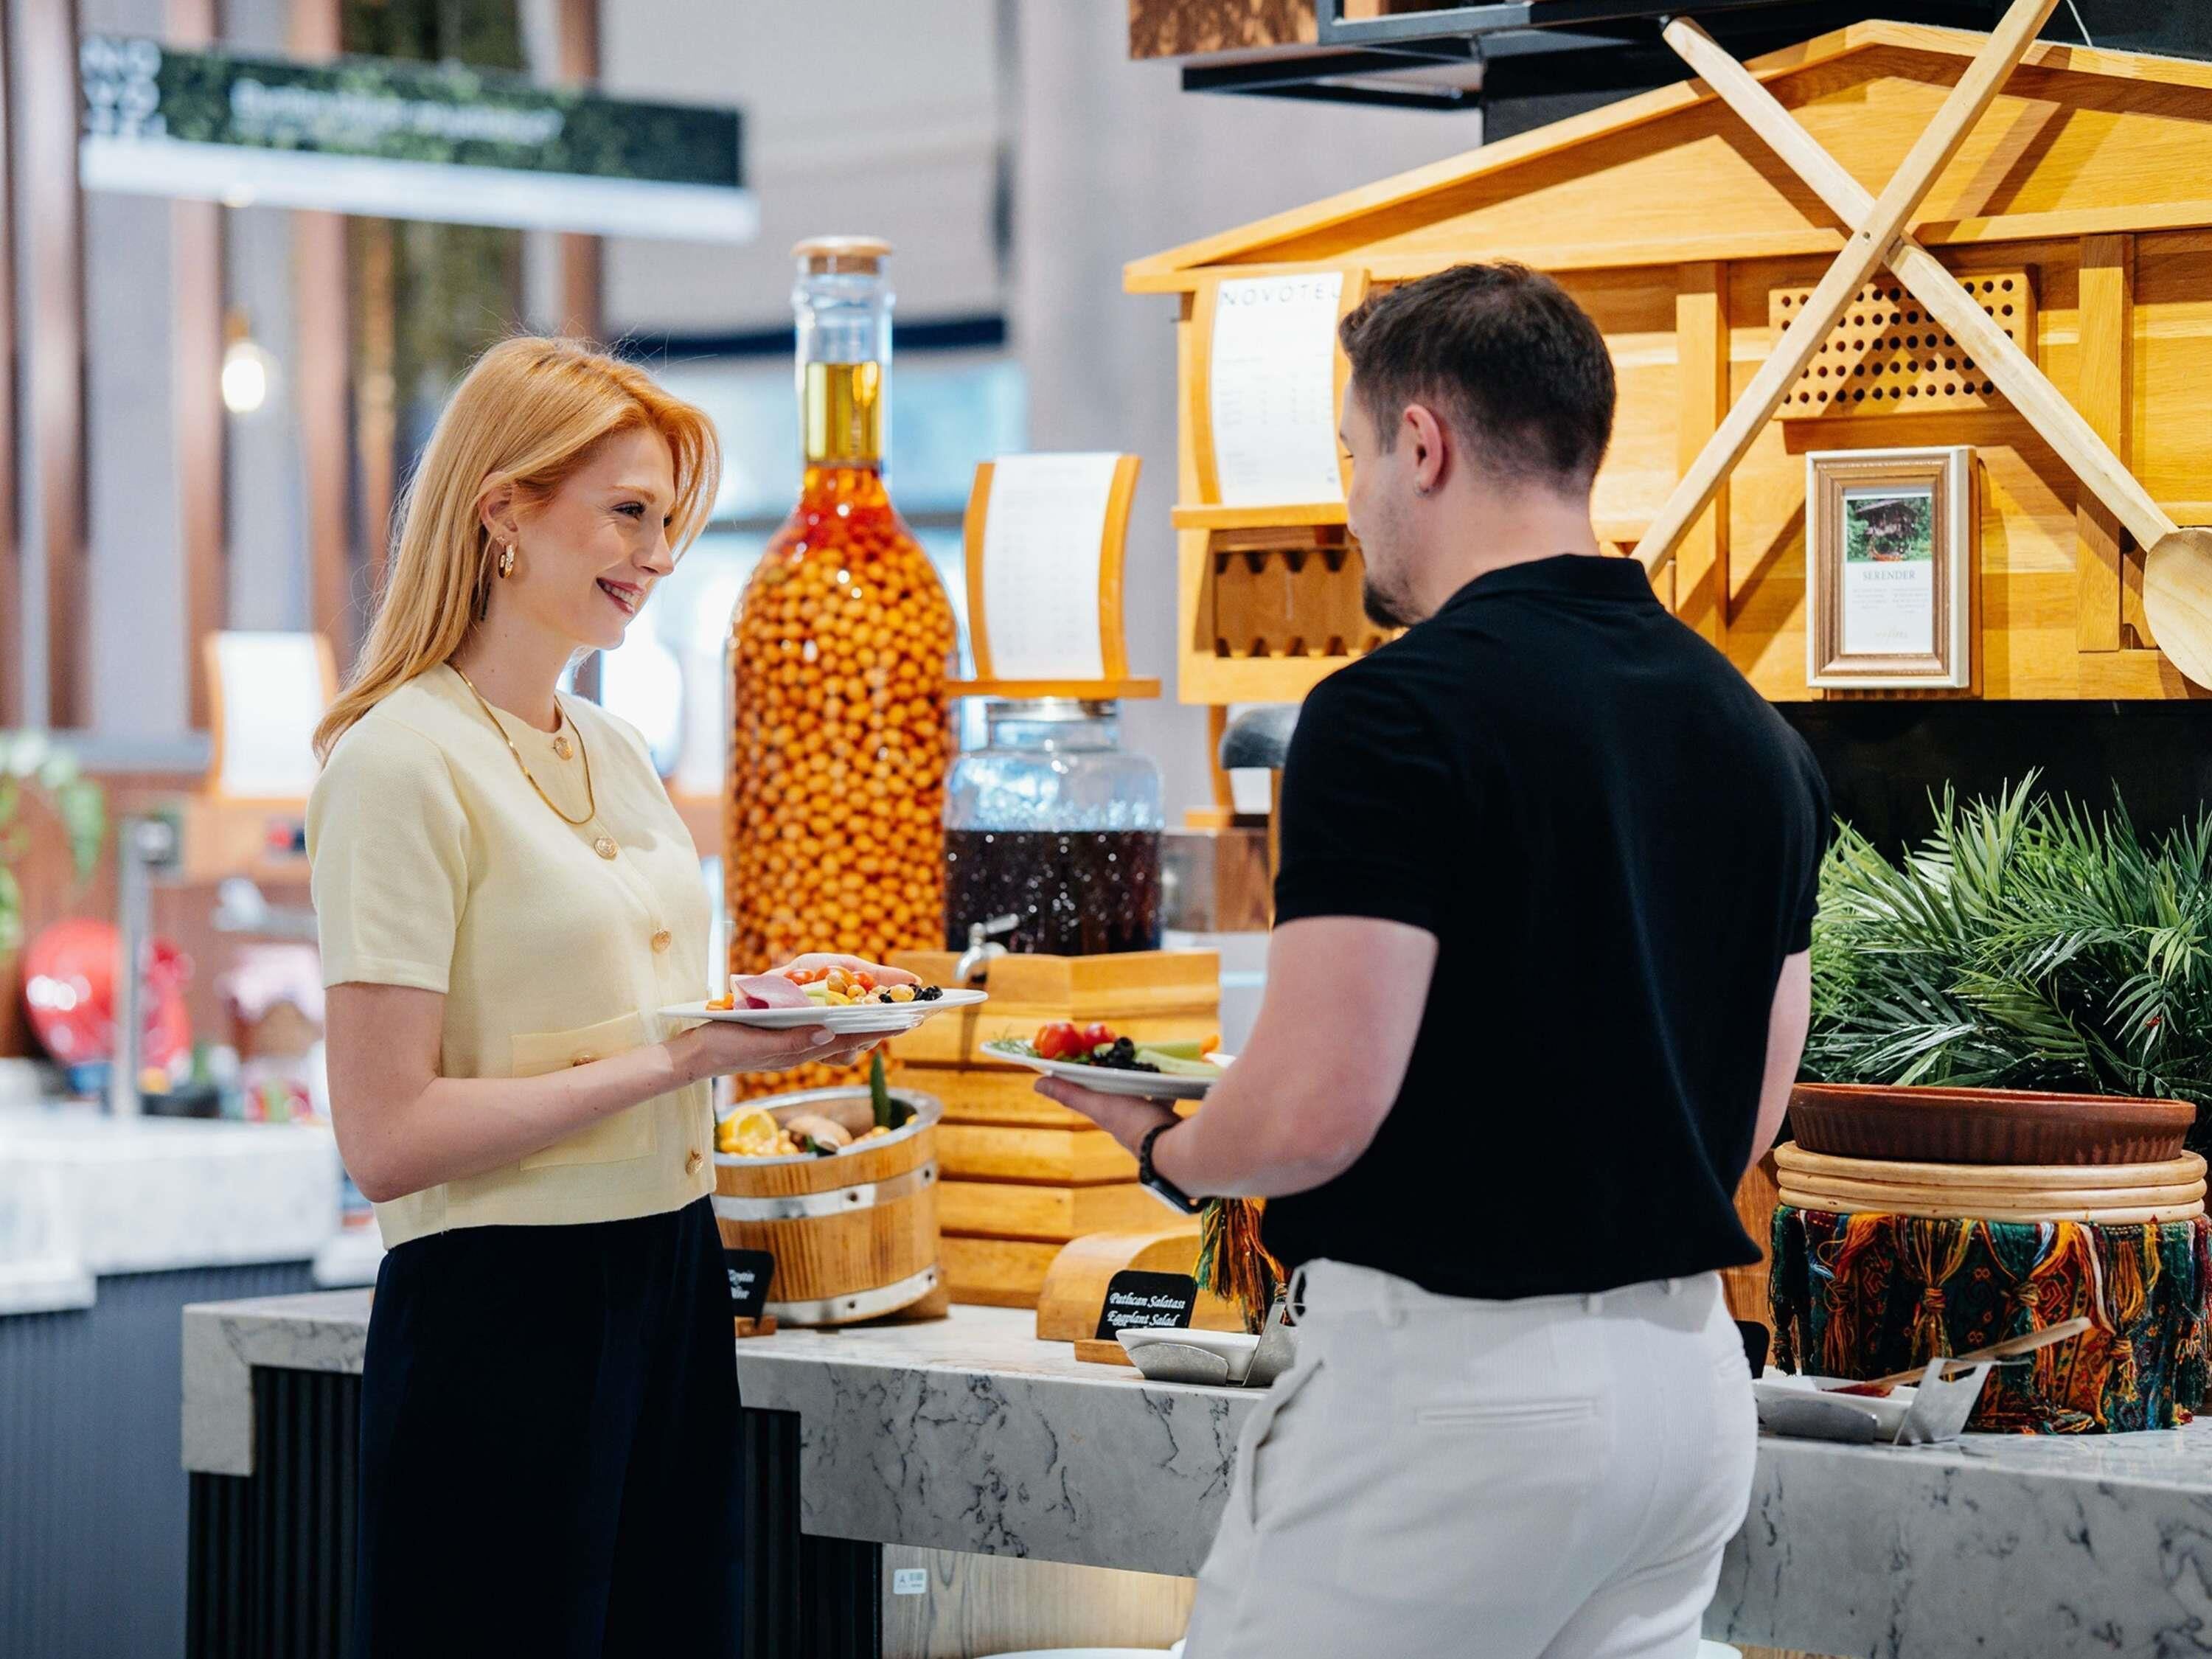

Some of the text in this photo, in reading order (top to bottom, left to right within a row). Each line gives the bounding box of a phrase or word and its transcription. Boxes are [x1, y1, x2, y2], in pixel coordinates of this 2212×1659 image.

[1863, 570, 1916, 580] SERENDER
[1107, 1310, 1180, 1326] Eggplant Salad
